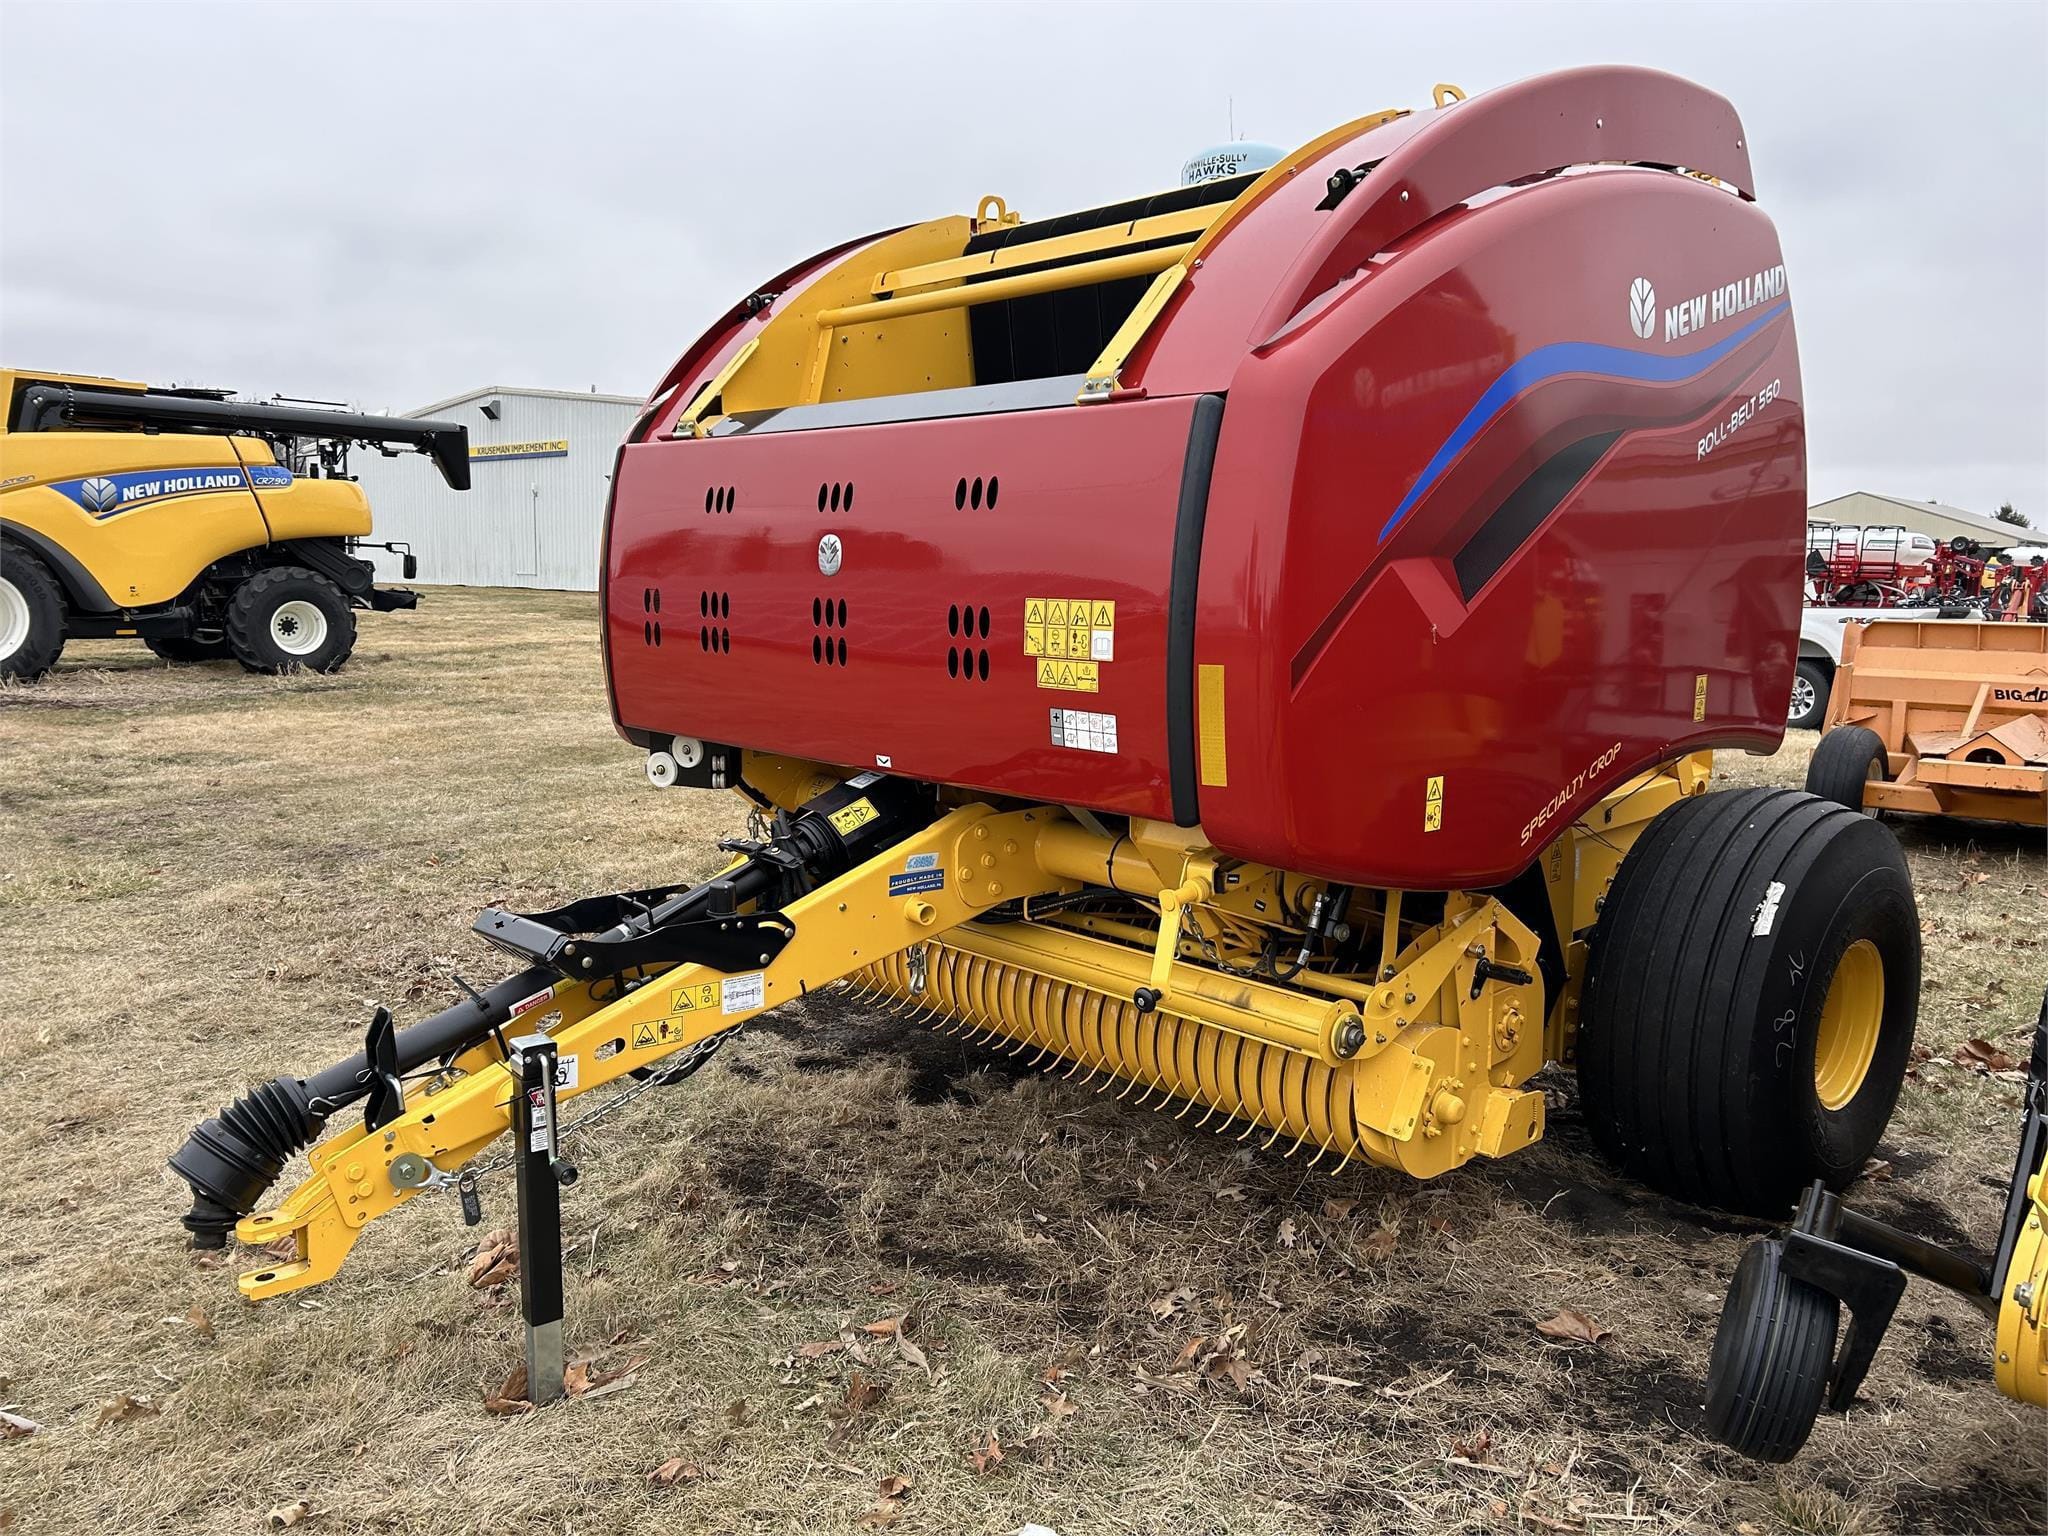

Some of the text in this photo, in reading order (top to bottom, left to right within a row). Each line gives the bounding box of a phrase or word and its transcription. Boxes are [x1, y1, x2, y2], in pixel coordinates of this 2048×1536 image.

[1188, 163, 1237, 184] HAWKS
[1665, 264, 1786, 343] NEW HOLLAND
[1697, 379, 1780, 461] ROLL-BELT 560
[477, 446, 510, 455] KRUSEMAN
[511, 442, 548, 453] IMPLEMENT
[122, 474, 240, 501] NEW HOLLAND
[1994, 689, 2022, 701] BIG
[1520, 742, 1621, 847] SPECIALTY CROP
[891, 877, 917, 887] PROUDLY
[525, 994, 549, 1009] DANGER
